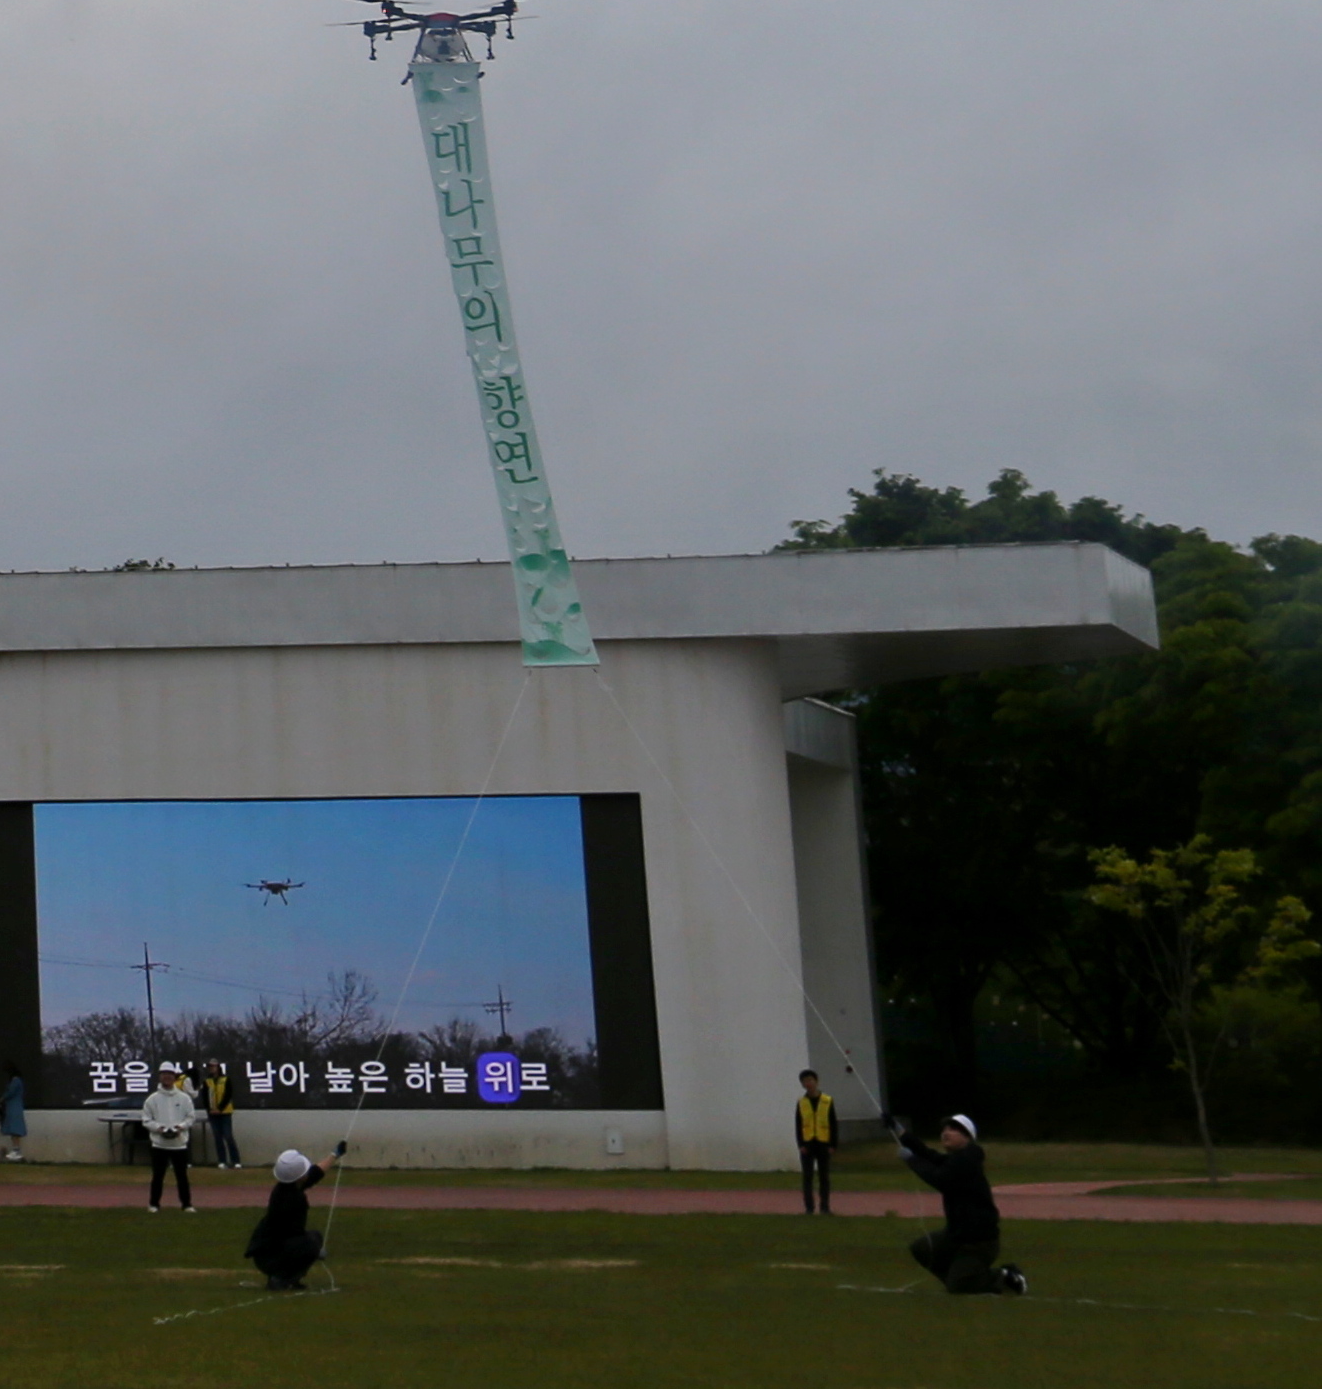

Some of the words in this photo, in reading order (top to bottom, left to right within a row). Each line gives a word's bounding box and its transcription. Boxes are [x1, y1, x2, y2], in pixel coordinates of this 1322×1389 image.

[431, 122, 503, 343] 대나무의
[483, 376, 538, 484] 향연
[89, 1061, 152, 1093] 꿈을
[246, 1061, 310, 1093] 날아
[324, 1061, 389, 1093] 높은
[404, 1061, 469, 1094] 하늘
[484, 1061, 551, 1094] 위로
